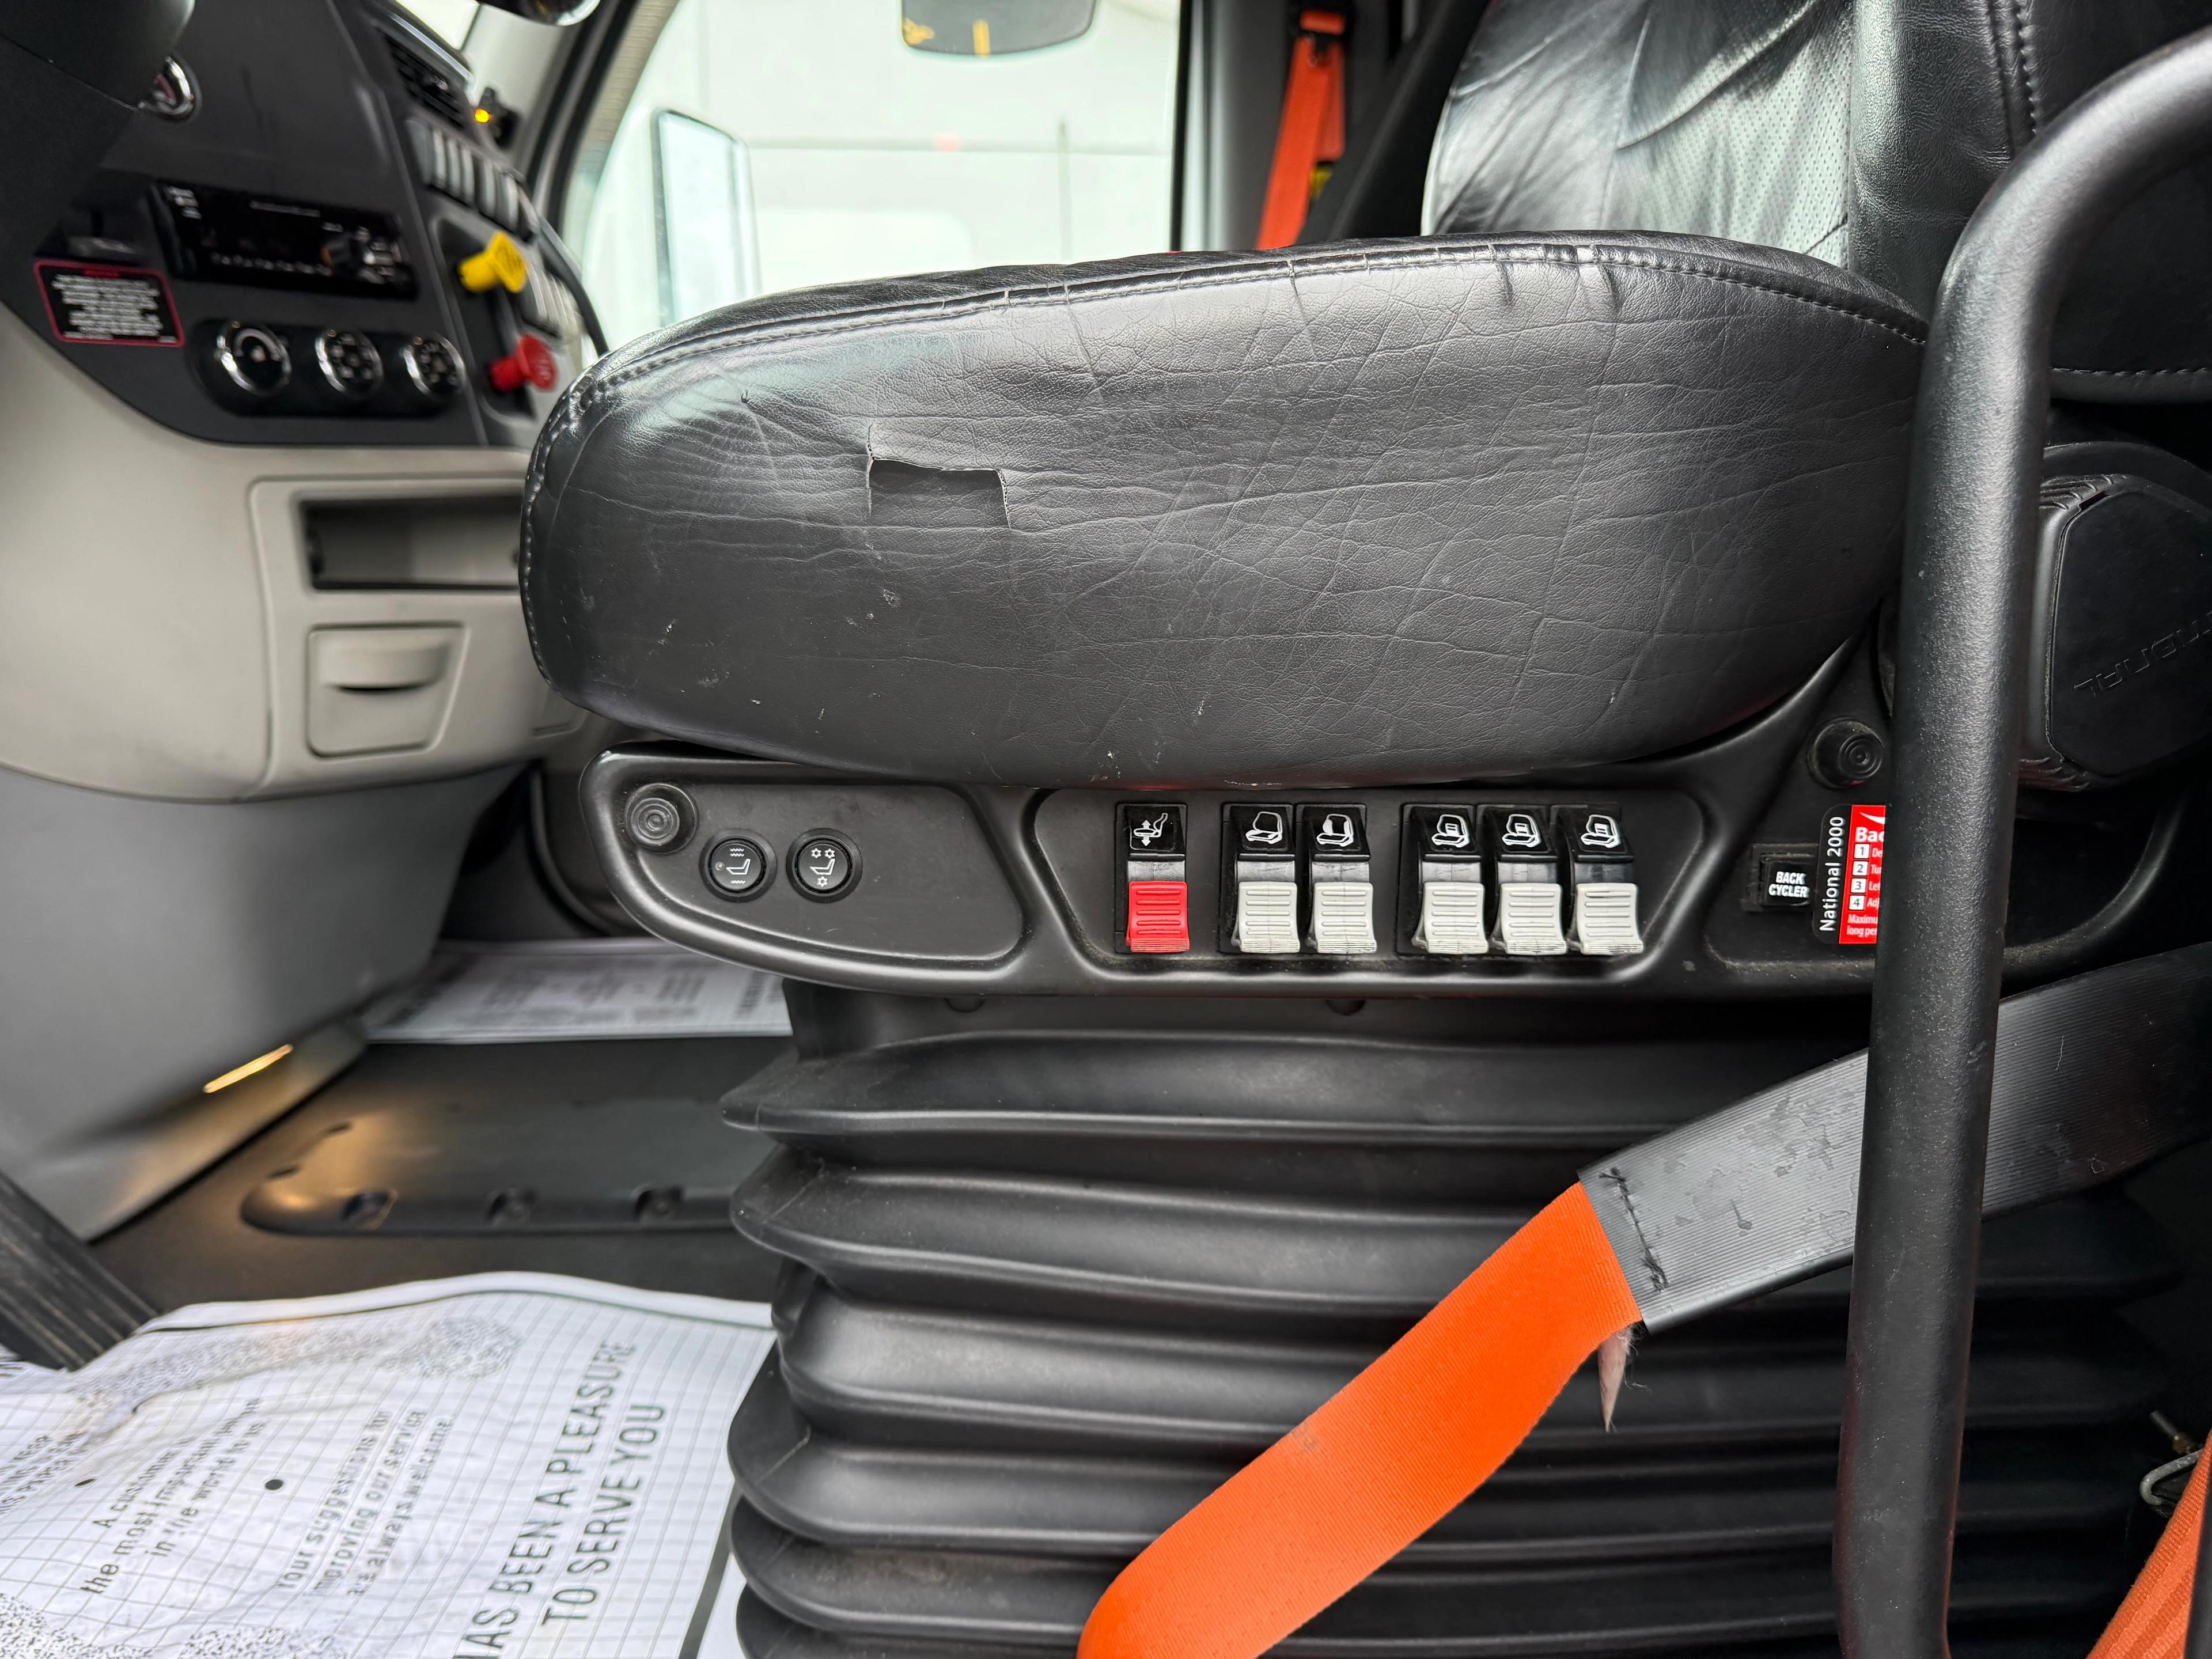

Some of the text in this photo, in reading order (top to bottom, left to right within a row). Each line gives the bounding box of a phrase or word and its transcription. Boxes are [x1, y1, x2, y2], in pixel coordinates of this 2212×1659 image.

[1776, 871, 1806, 885] BACK
[1819, 817, 1844, 931] National 2000
[1768, 883, 1810, 898] CYCLER
[1846, 925, 1864, 938] long
[544, 1340, 637, 1475] PLEASURE
[533, 1487, 577, 1509] A
[92, 1517, 119, 1528] A
[540, 1404, 666, 1626] TO SERVE YOU
[79, 1562, 120, 1594] the
[112, 1511, 159, 1555] most
[144, 1540, 176, 1558] in
[488, 1520, 563, 1594] BEEN
